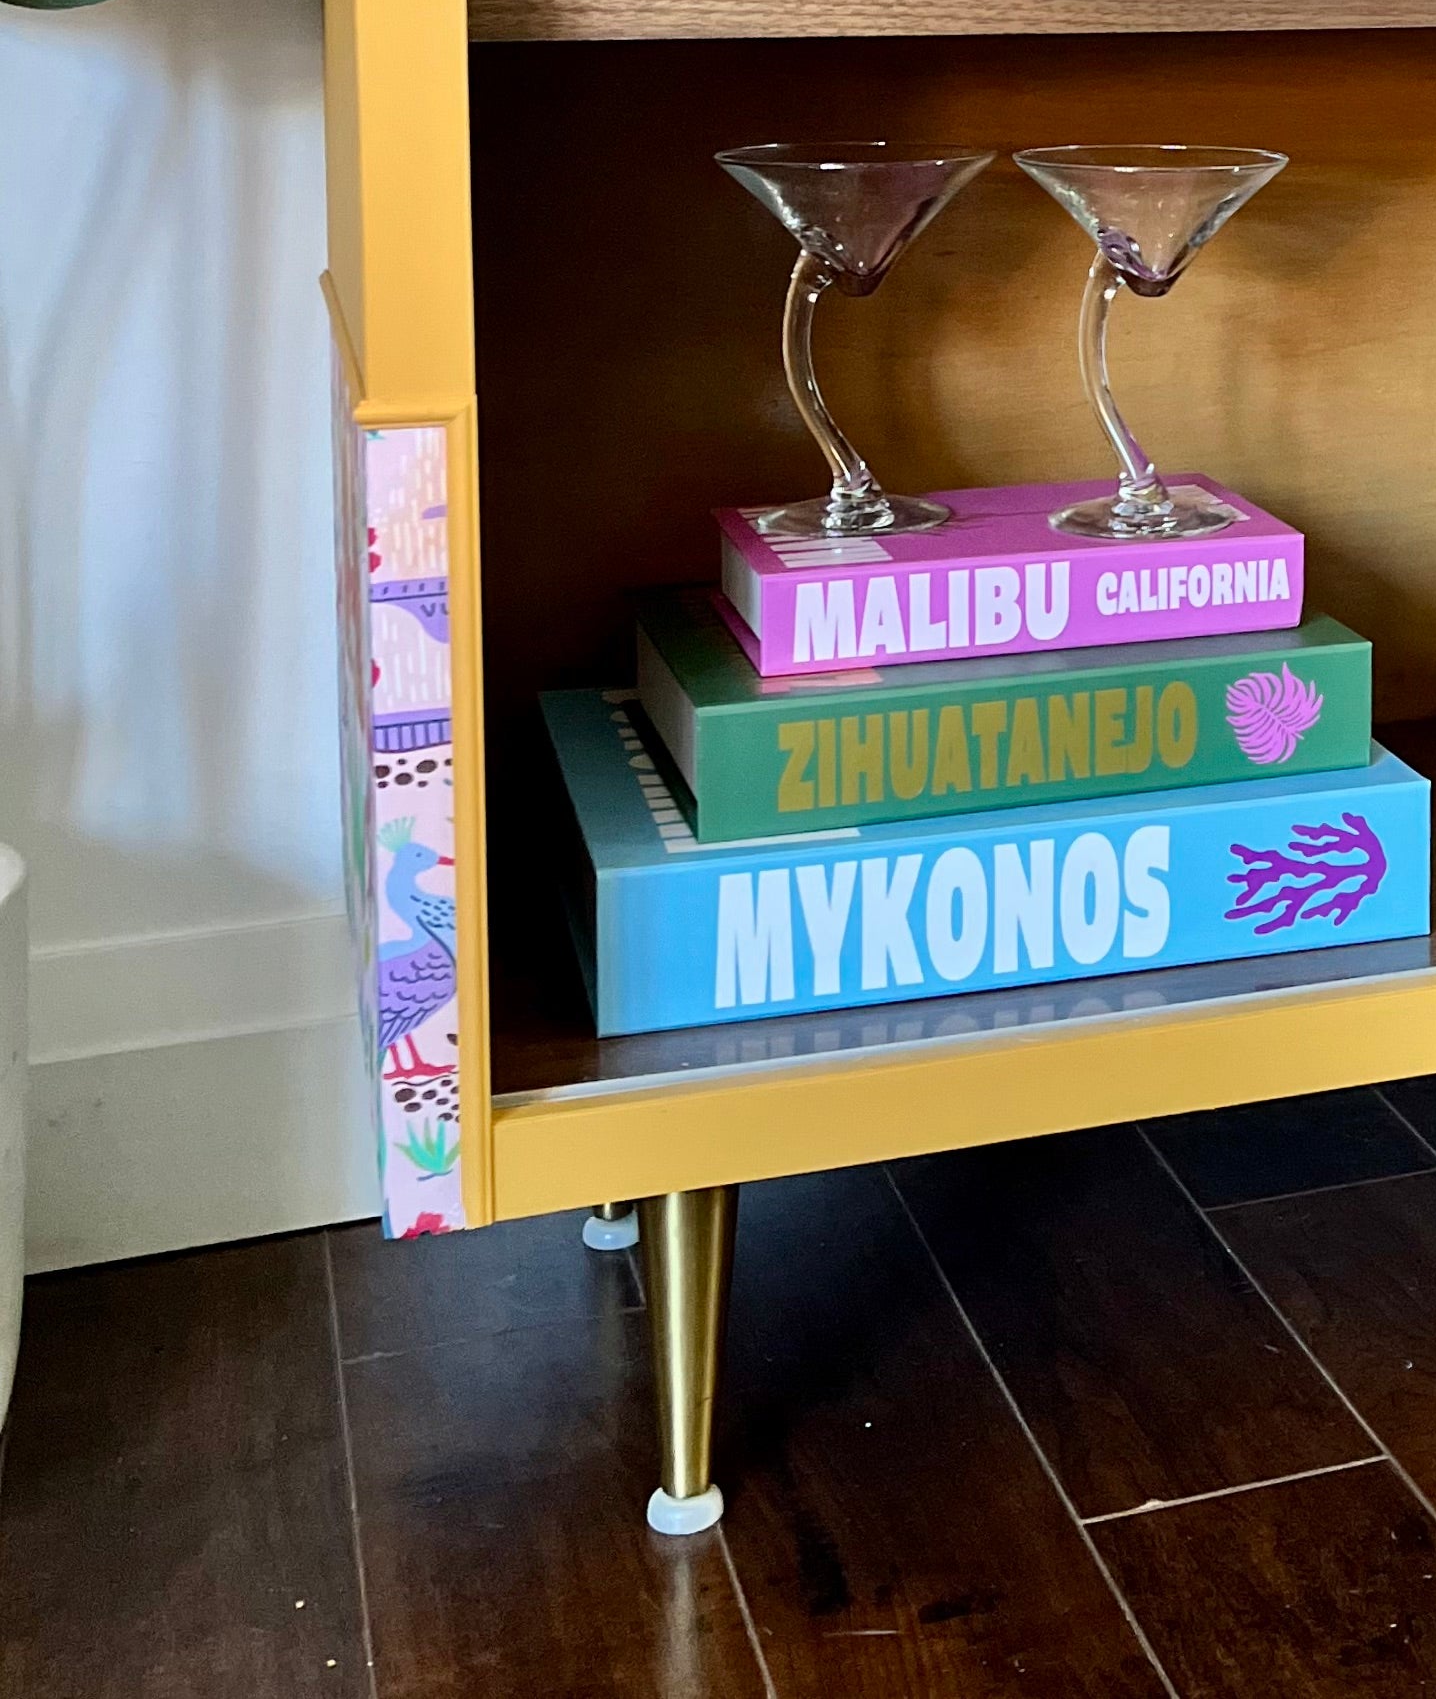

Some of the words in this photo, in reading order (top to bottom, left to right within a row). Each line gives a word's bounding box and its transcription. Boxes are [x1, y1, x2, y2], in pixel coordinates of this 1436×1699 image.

[792, 561, 1070, 664] MALIBU
[1095, 558, 1291, 616] CALIFORNIA
[777, 681, 1198, 813] ZIHUATANEJO
[715, 825, 1171, 1009] MYKONOS
